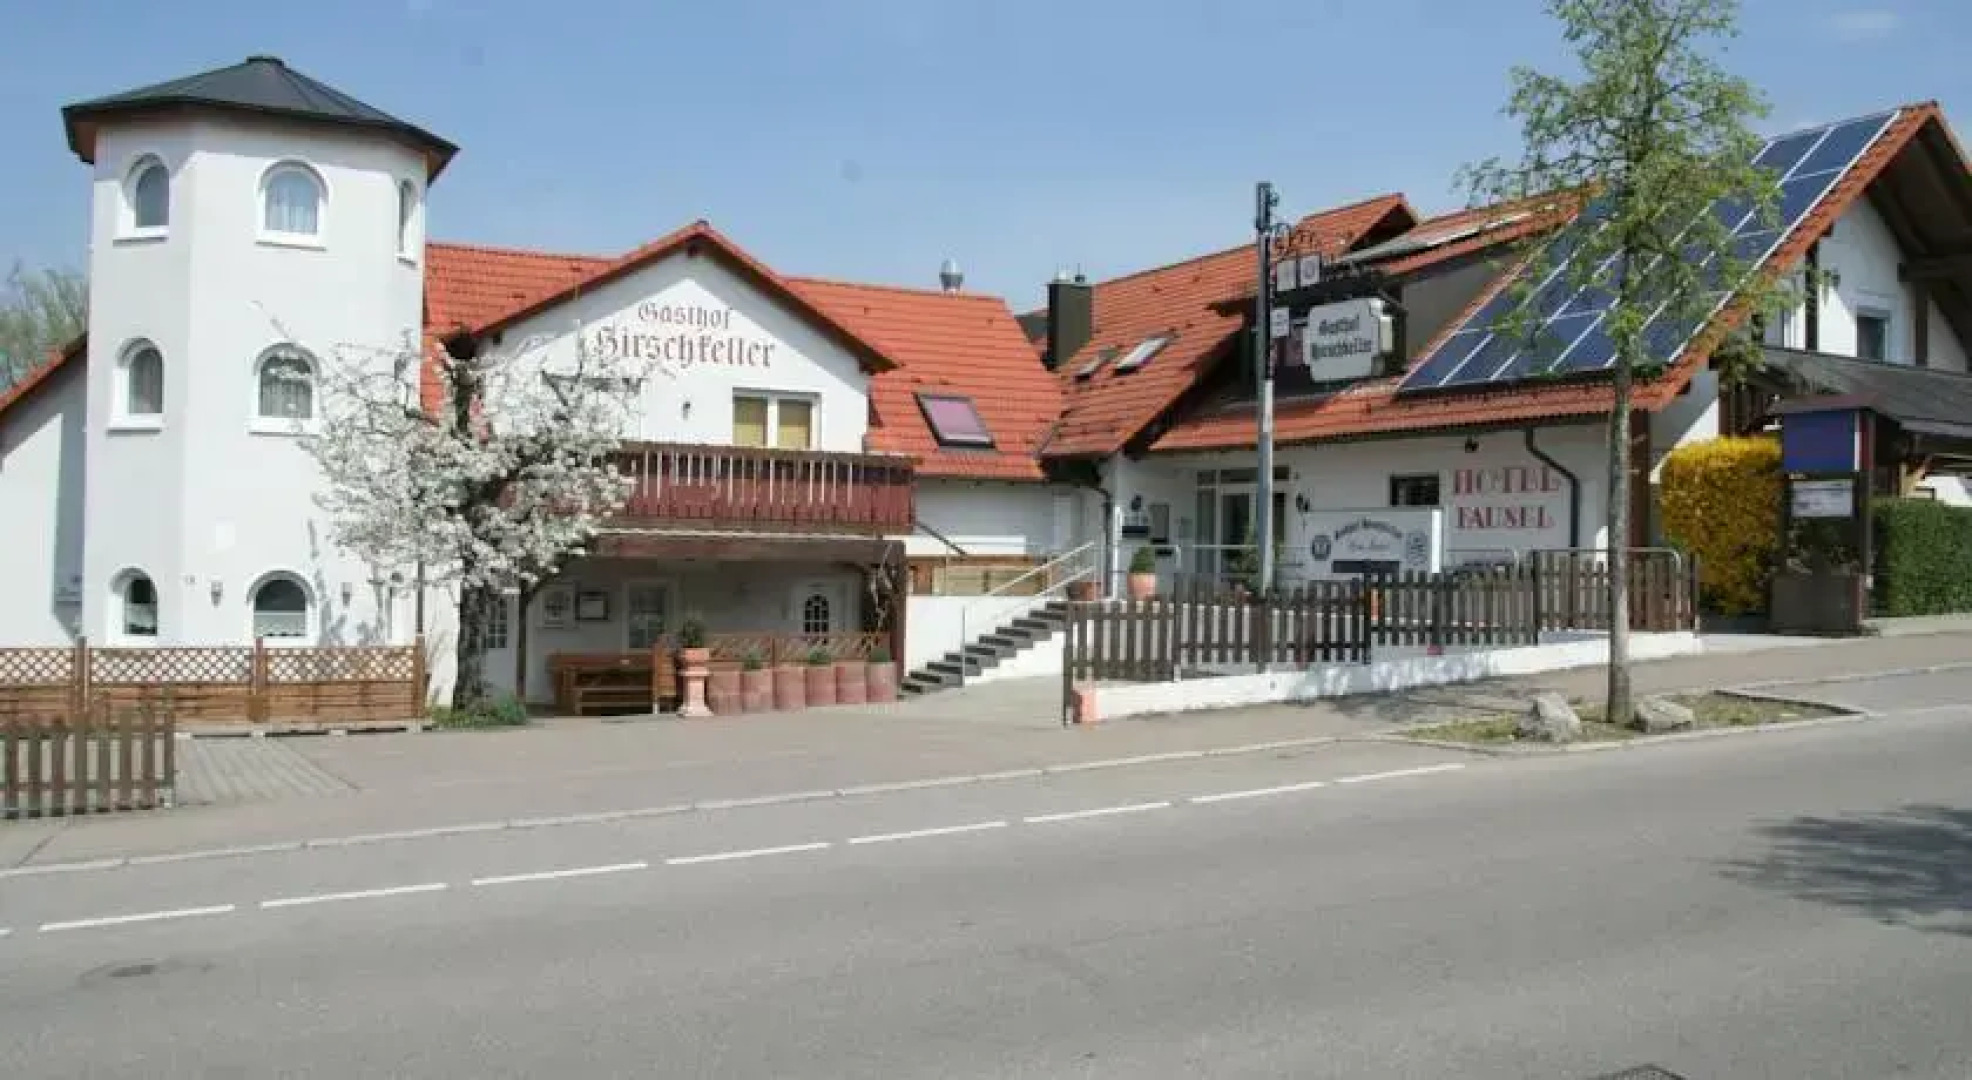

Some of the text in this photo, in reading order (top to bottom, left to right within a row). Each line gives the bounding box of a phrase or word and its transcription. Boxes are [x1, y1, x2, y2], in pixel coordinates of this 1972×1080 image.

[637, 302, 734, 329] Gasthof
[595, 326, 776, 369] Hirschkeller
[1454, 467, 1561, 493] HOTEL
[1457, 506, 1557, 528] FAUSEL
